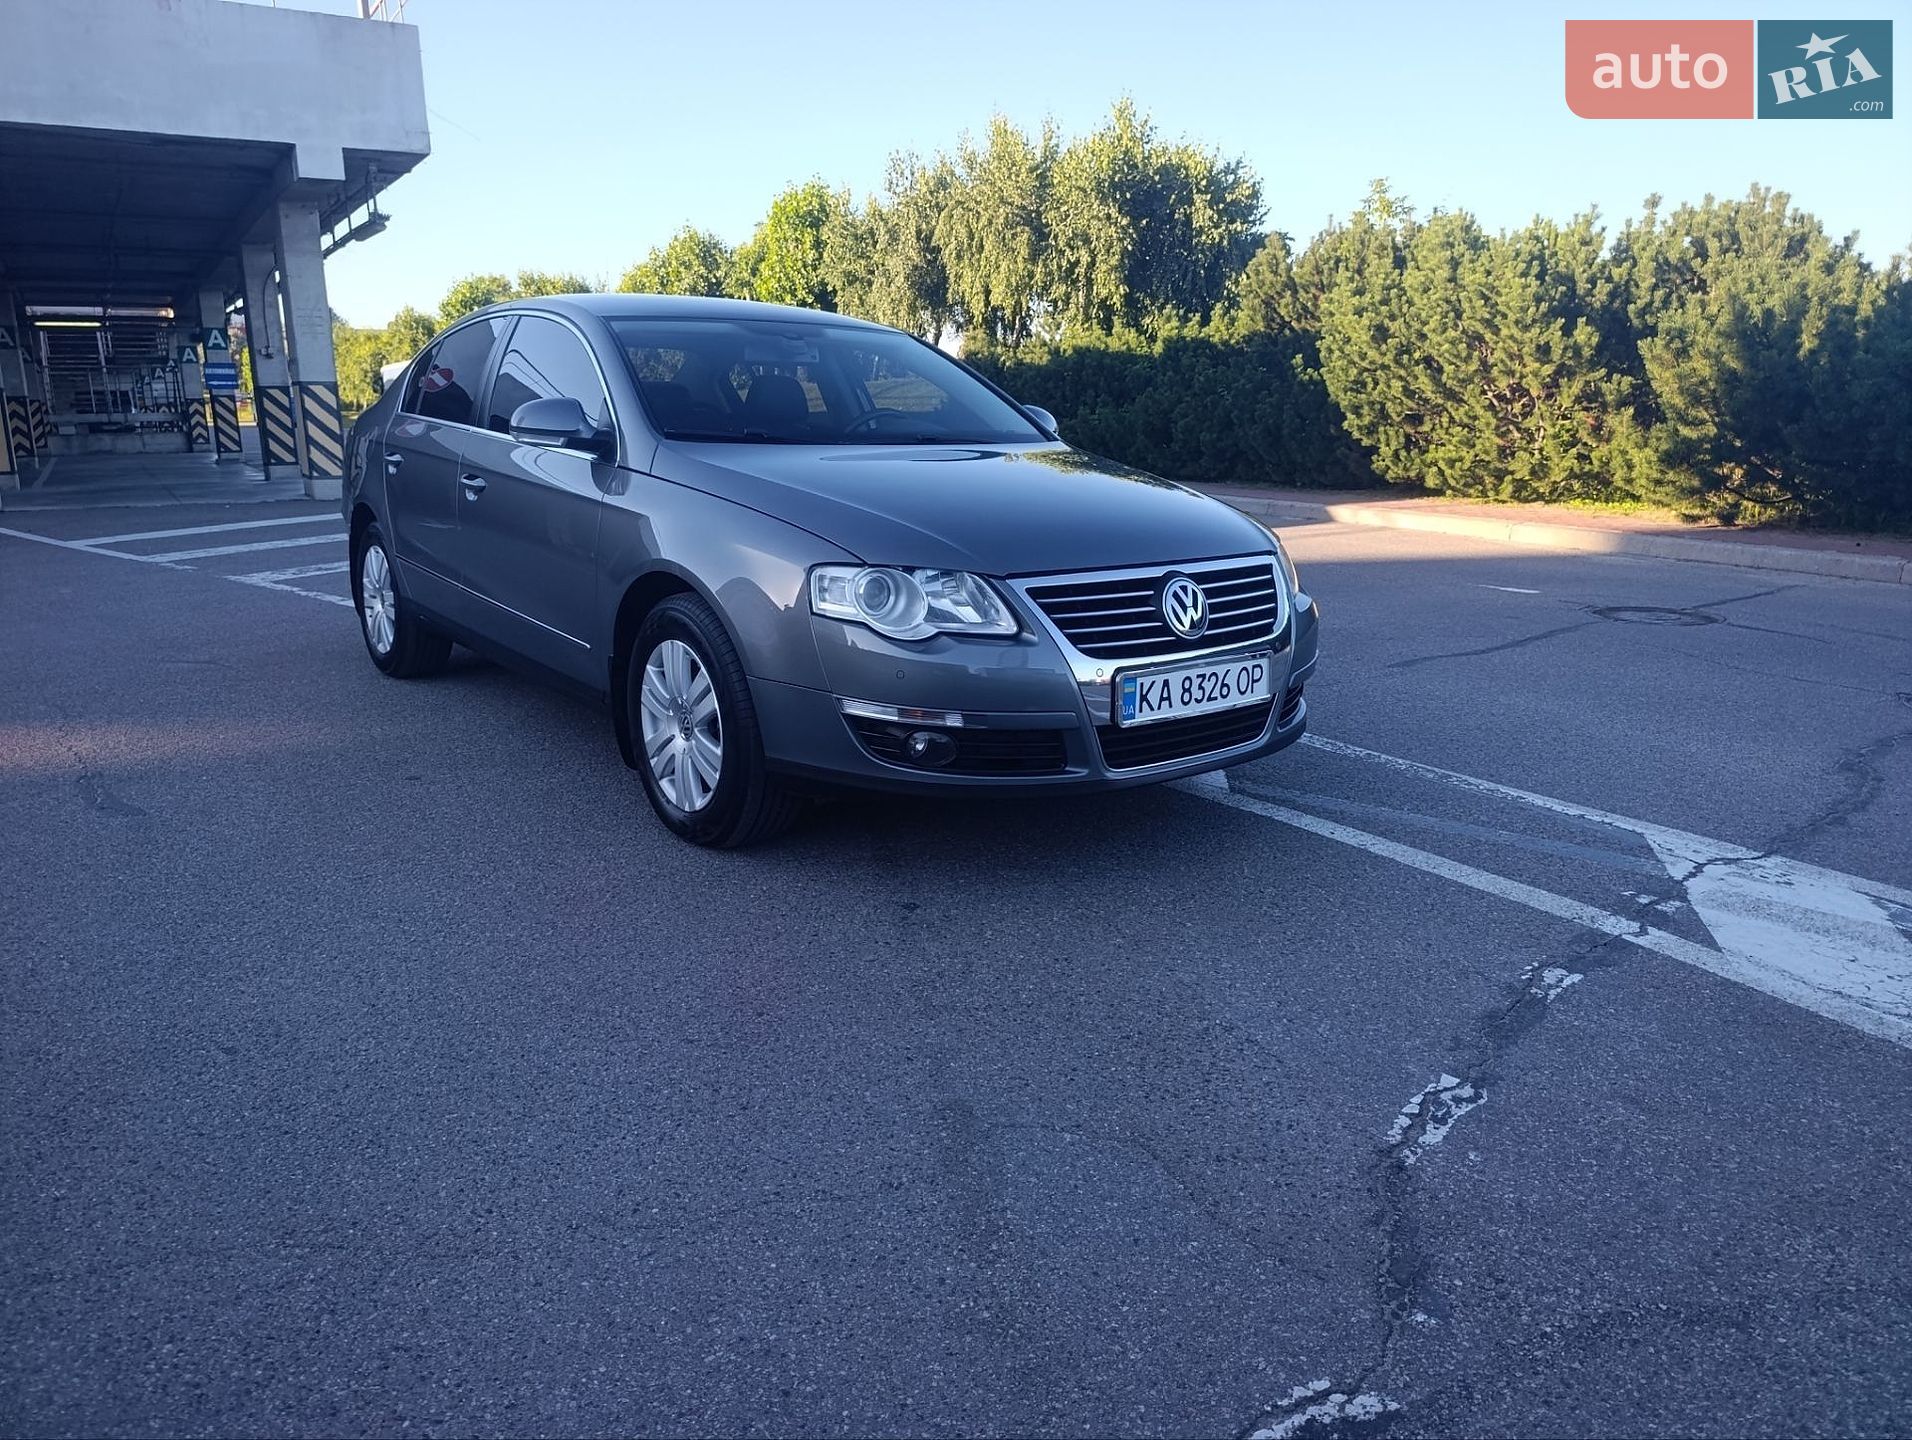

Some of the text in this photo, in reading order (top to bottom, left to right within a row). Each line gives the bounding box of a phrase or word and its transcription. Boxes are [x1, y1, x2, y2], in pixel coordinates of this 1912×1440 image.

[208, 329, 226, 348] A
[182, 347, 197, 362] A
[1165, 582, 1206, 635] VW
[1138, 664, 1264, 713] KA 8326 OP
[1122, 705, 1135, 715] UA
